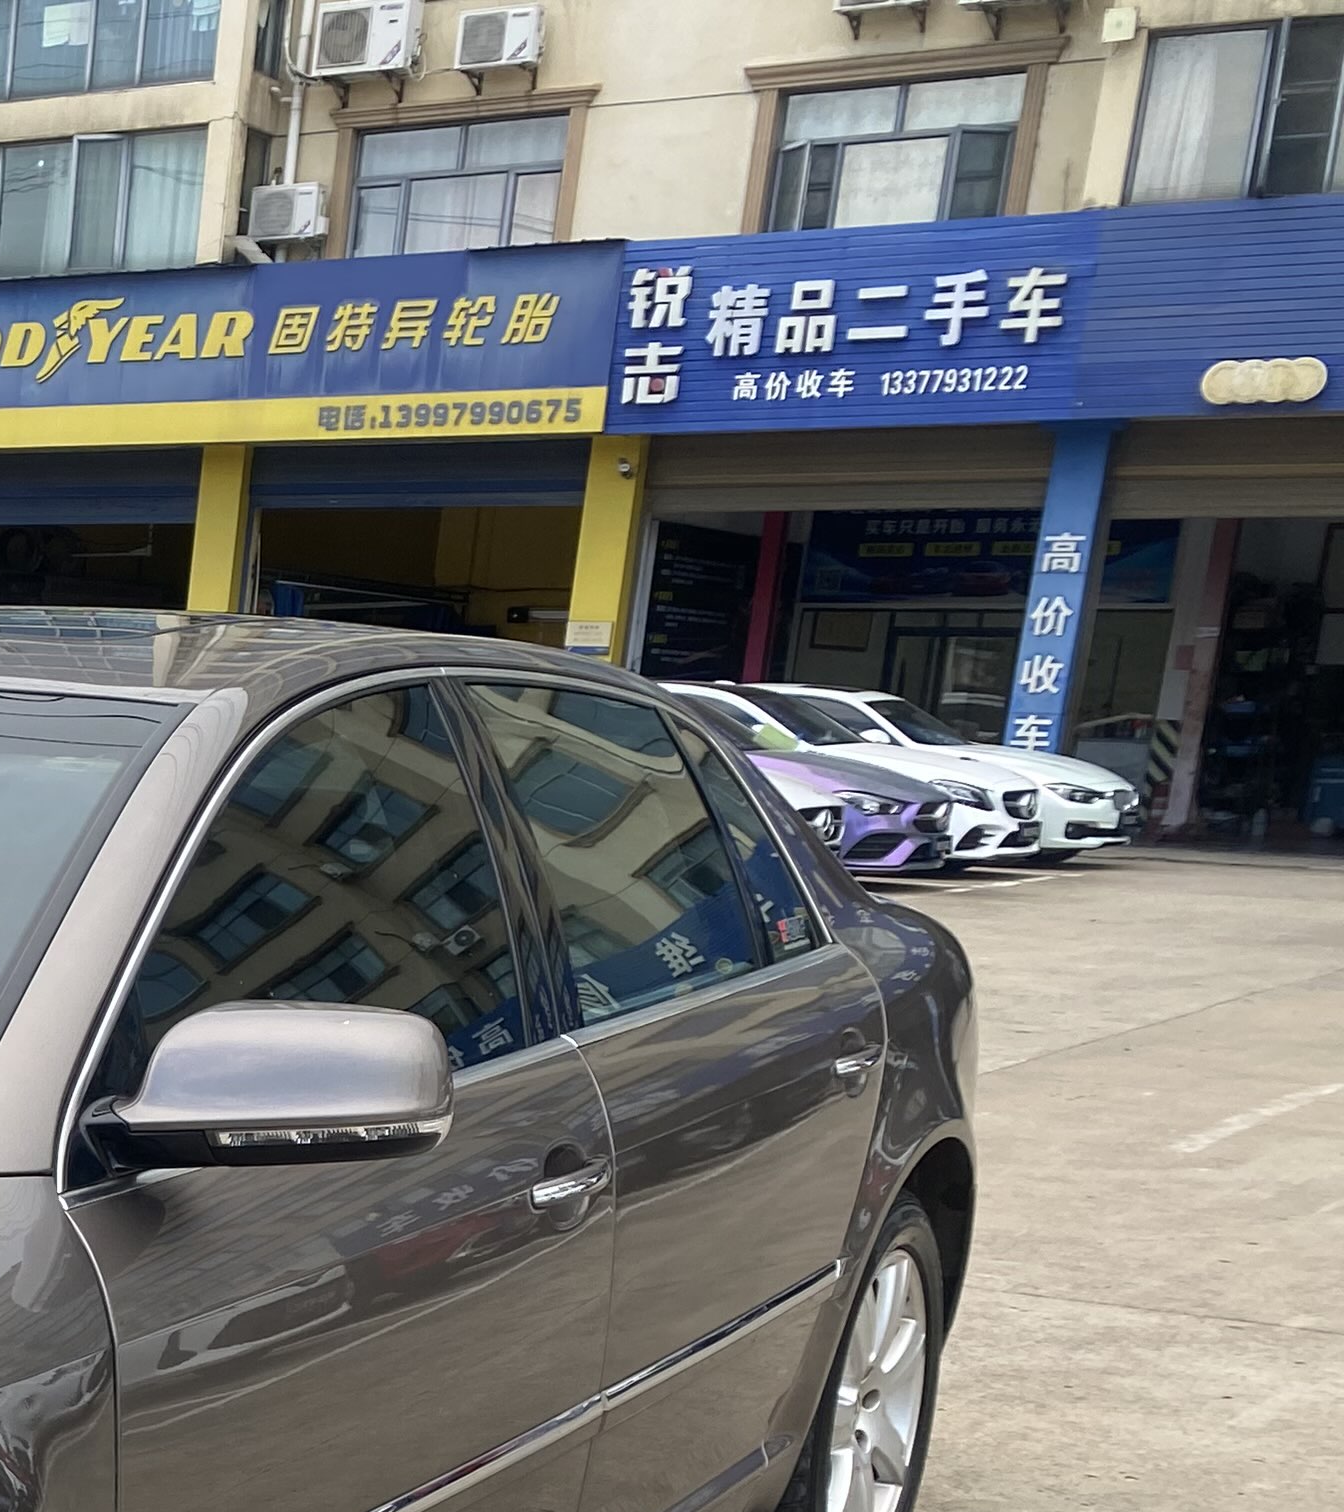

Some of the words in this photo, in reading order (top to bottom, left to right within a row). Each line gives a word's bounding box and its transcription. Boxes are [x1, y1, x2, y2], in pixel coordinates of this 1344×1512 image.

[268, 292, 561, 356] 固特异轮胎
[621, 265, 692, 405] 锐志
[706, 266, 1069, 357] 精品二手车
[733, 367, 856, 401] 高价收车
[880, 365, 1029, 397] 13377931222
[1010, 532, 1087, 751] 高价收车
